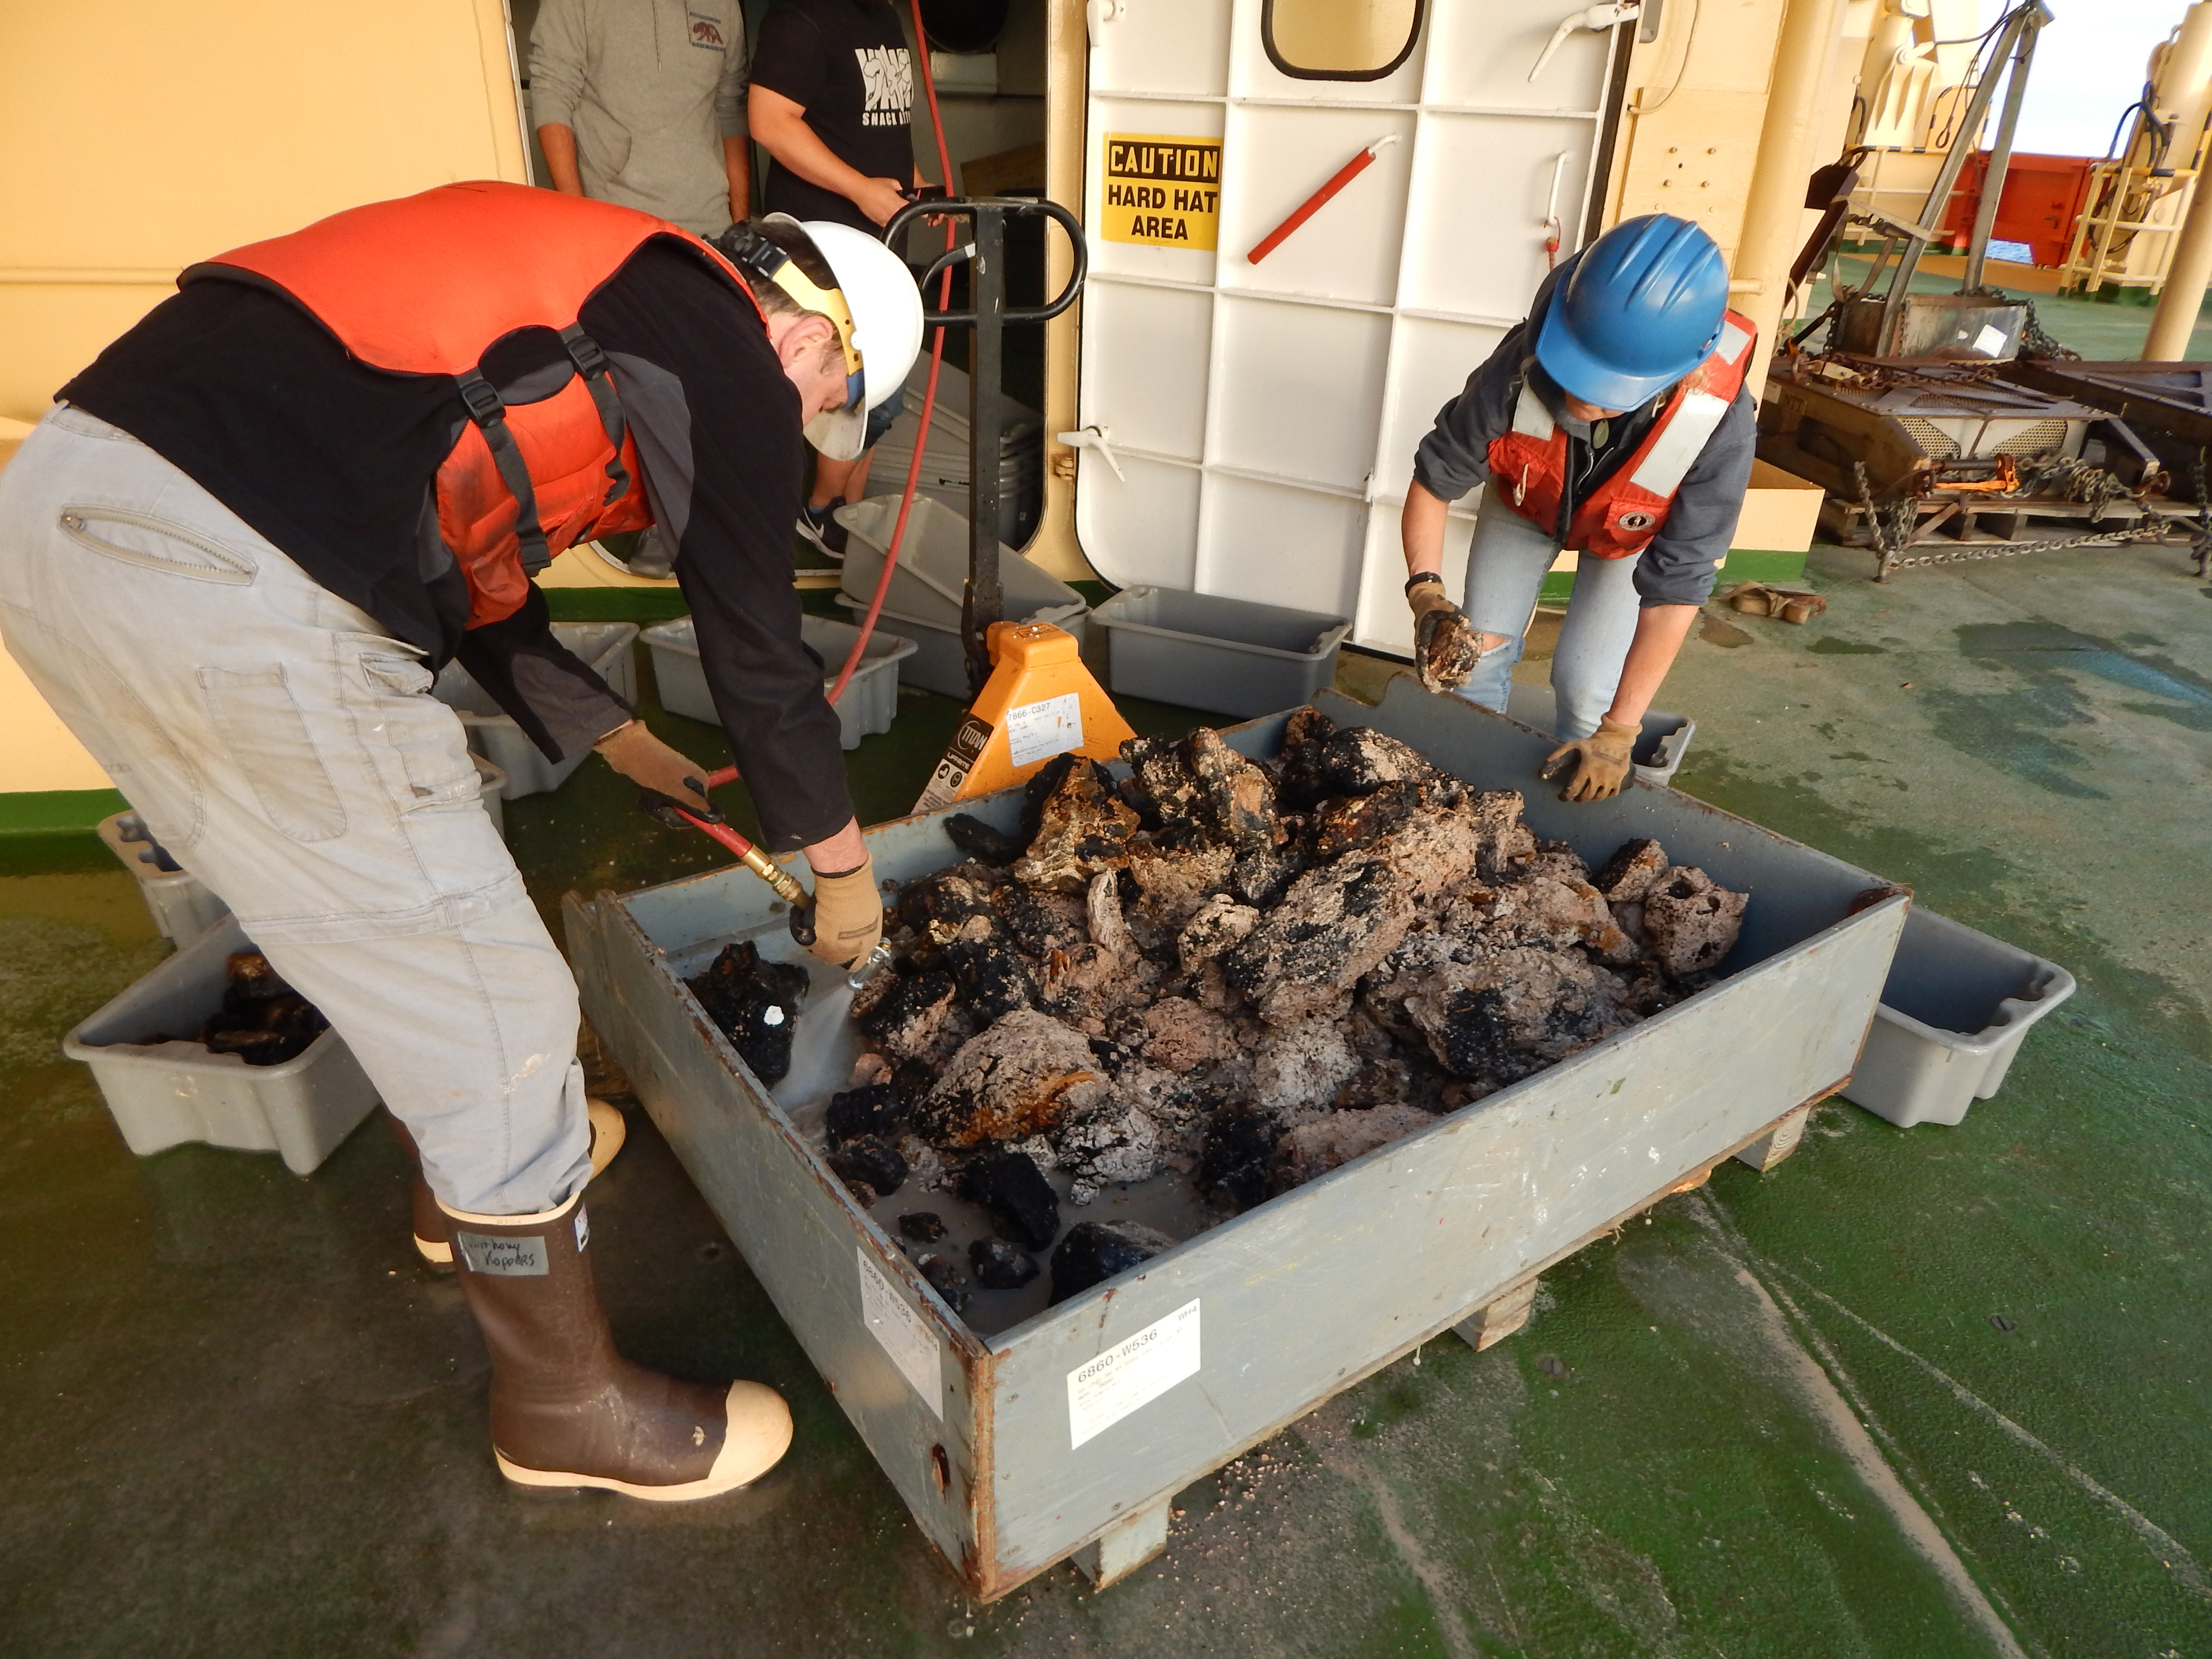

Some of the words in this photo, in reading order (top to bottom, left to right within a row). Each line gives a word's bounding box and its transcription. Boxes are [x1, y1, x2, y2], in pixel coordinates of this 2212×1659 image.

[862, 112, 897, 126] SNACK
[1111, 145, 1218, 178] CAUTION
[1108, 184, 1166, 209] HARD
[1174, 189, 1218, 213] HAT
[1131, 215, 1188, 240] AREA
[1007, 702, 1051, 721] 7866-C327
[961, 725, 988, 751] TITAN
[1078, 1328, 1158, 1383] 6860-W536
